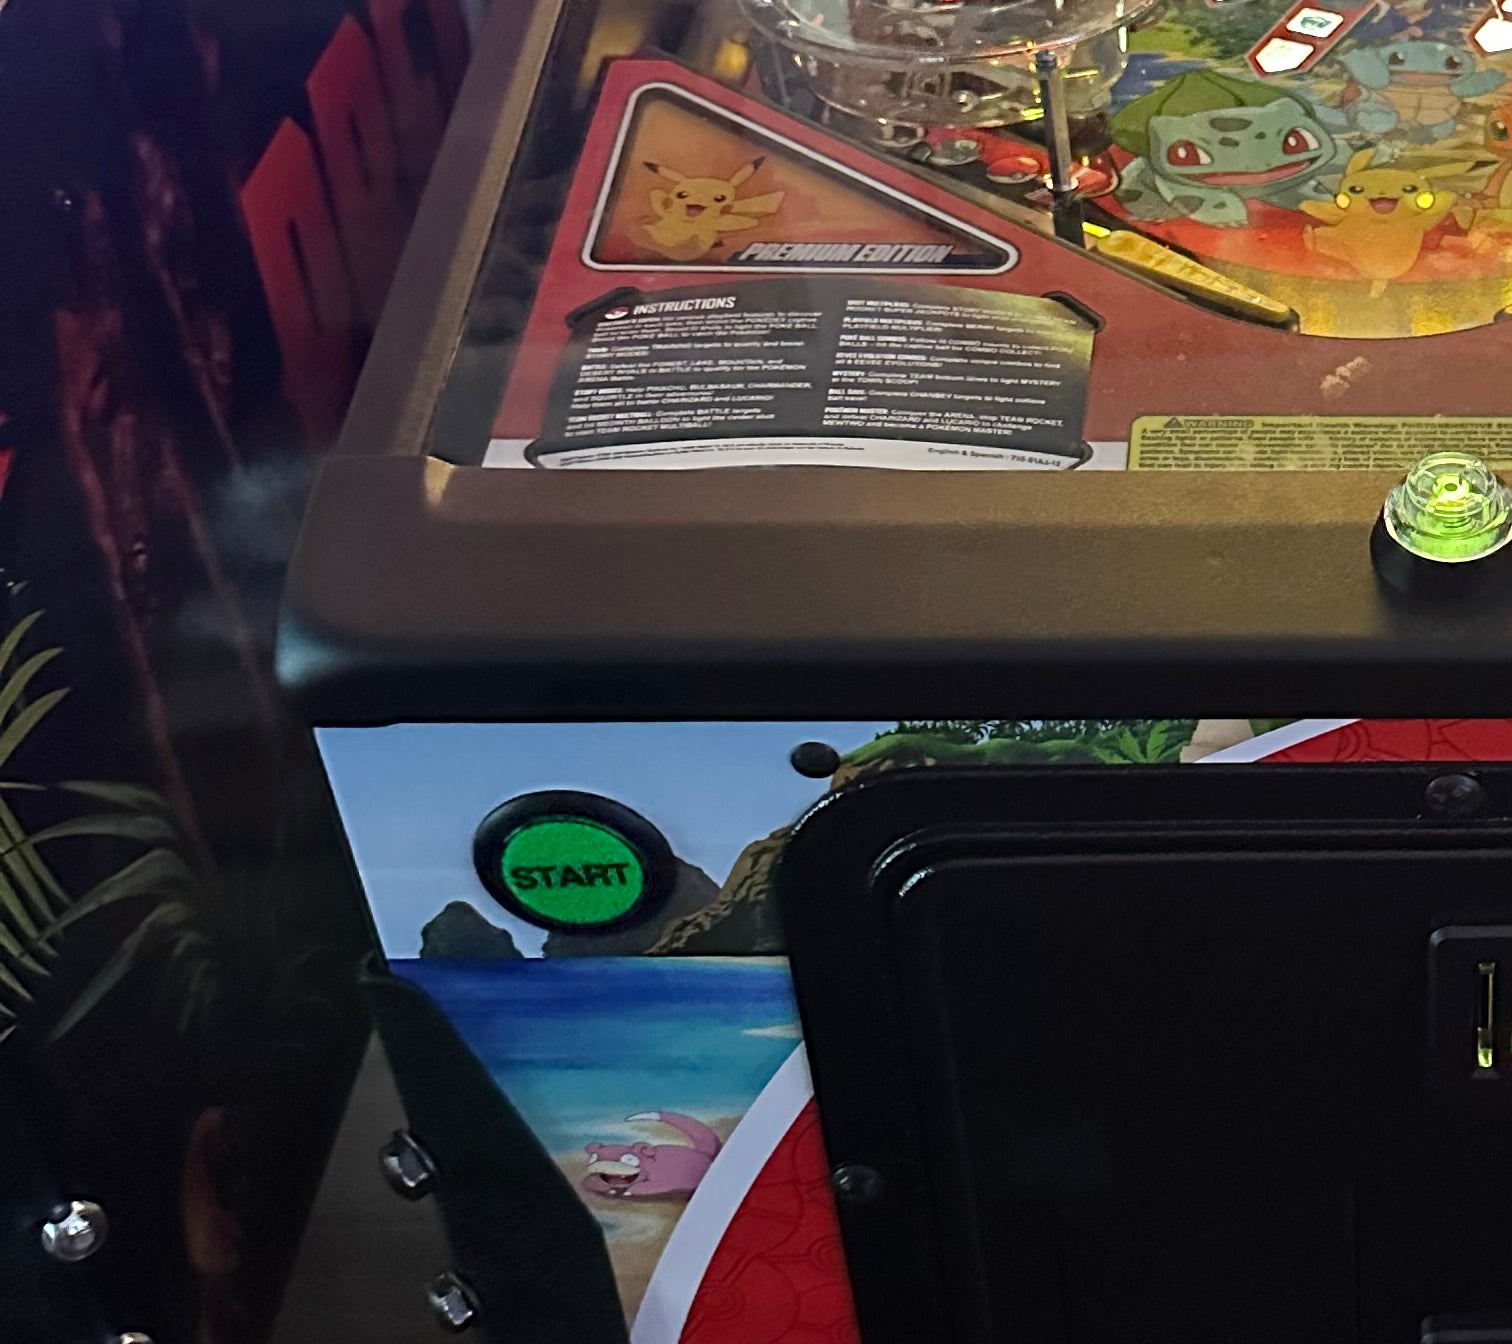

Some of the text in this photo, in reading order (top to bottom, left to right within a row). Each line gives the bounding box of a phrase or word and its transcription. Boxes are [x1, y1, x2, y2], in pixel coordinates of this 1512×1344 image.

[738, 242, 953, 262] PREMIUM EDITION
[633, 296, 737, 316] INSTRUCTIONS
[510, 861, 630, 891] START
